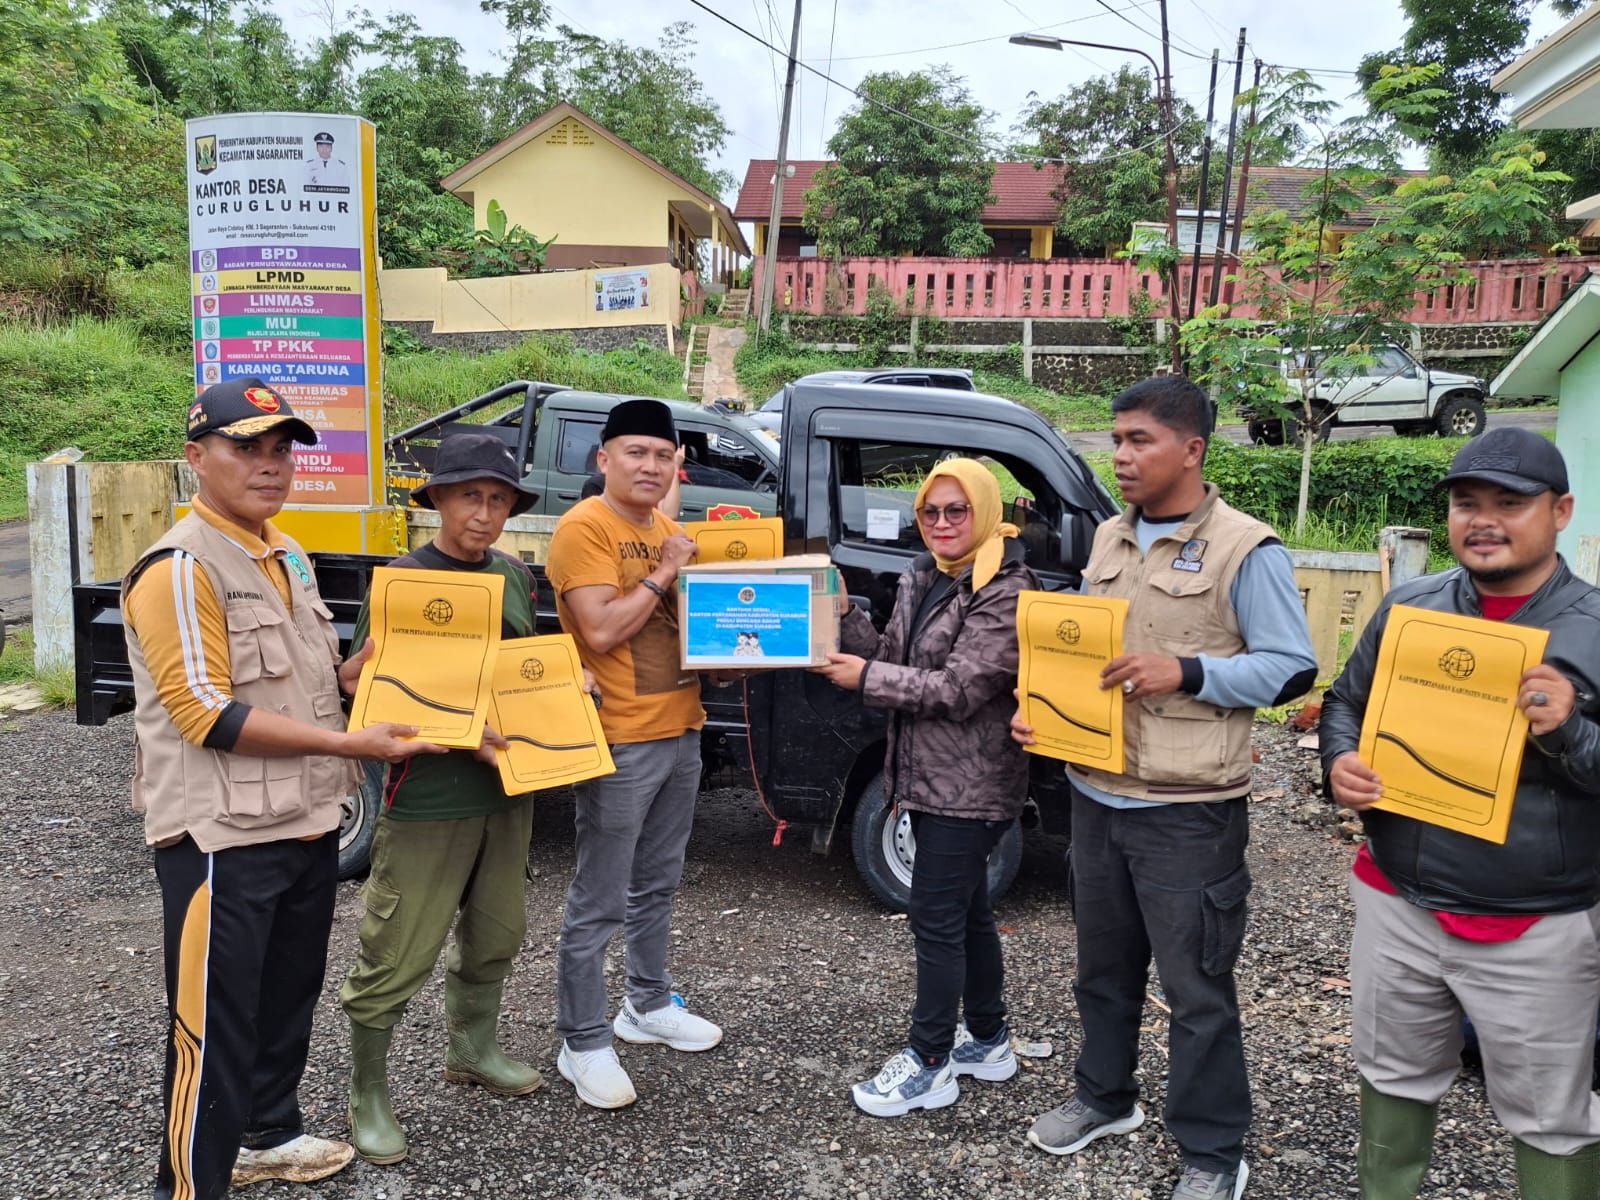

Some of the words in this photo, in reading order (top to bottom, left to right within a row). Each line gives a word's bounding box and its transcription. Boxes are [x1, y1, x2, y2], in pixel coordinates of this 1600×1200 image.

[218, 138, 245, 148] PEMERINTAH
[245, 136, 275, 146] KABUPATEN
[275, 136, 304, 145] SUKABUMI
[219, 149, 255, 162] KECAMATAN
[256, 149, 304, 160] SAGARANTEN
[195, 180, 241, 200] KANTOR
[248, 178, 287, 194] DESA
[261, 247, 298, 260] BPD
[256, 271, 305, 283] LPMD
[250, 294, 314, 307] LINMAS
[265, 317, 298, 329] MUI
[252, 340, 273, 352] TP
[277, 340, 315, 352] PKK
[228, 364, 282, 375] KARANG
[286, 364, 350, 376] TARUNA
[271, 385, 348, 396] KAMTIBMAS
[303, 465, 345, 473] TERPADU
[293, 480, 337, 492] DESA
